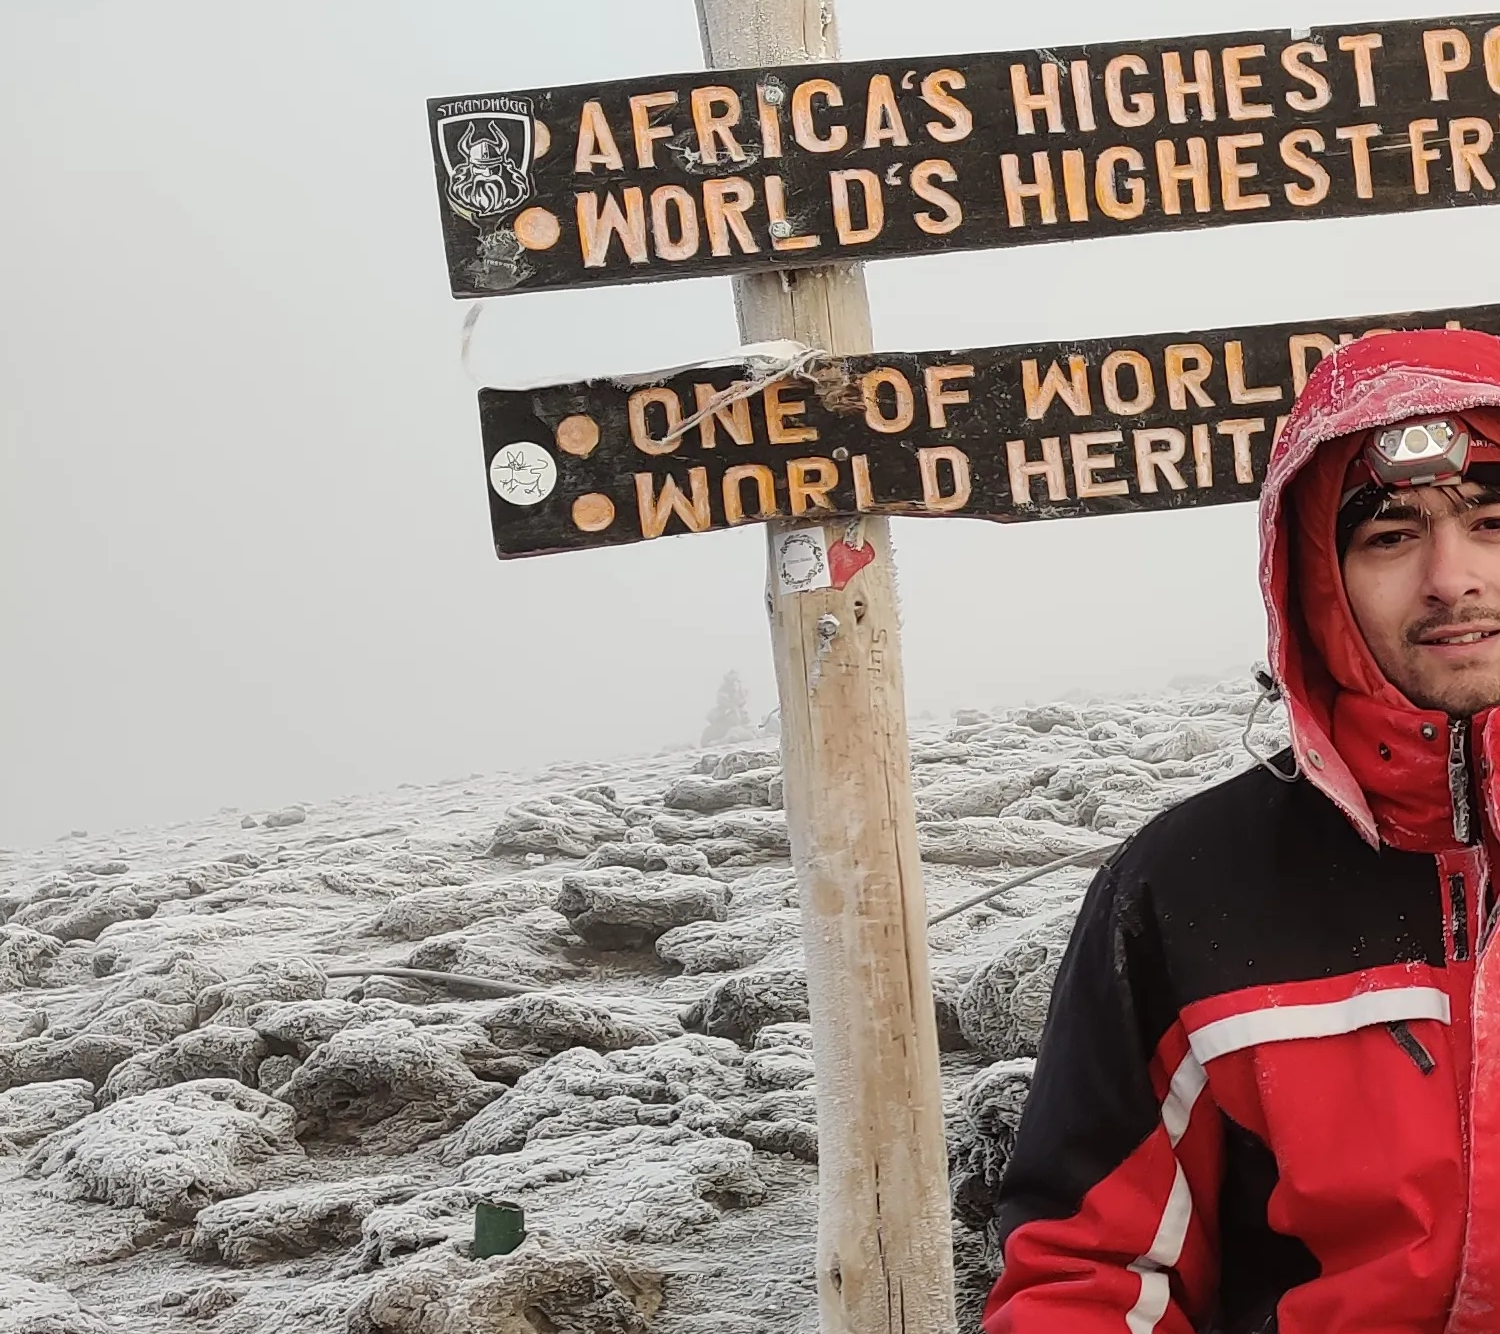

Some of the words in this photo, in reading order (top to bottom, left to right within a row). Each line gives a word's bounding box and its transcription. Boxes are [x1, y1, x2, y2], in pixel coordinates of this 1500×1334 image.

[437, 96, 529, 117] STRANDHÖGG
[1008, 31, 1383, 137] HIGHEST
[1000, 122, 1382, 227] HIGHEST
[627, 377, 819, 455] ONE
[860, 363, 976, 434] OF
